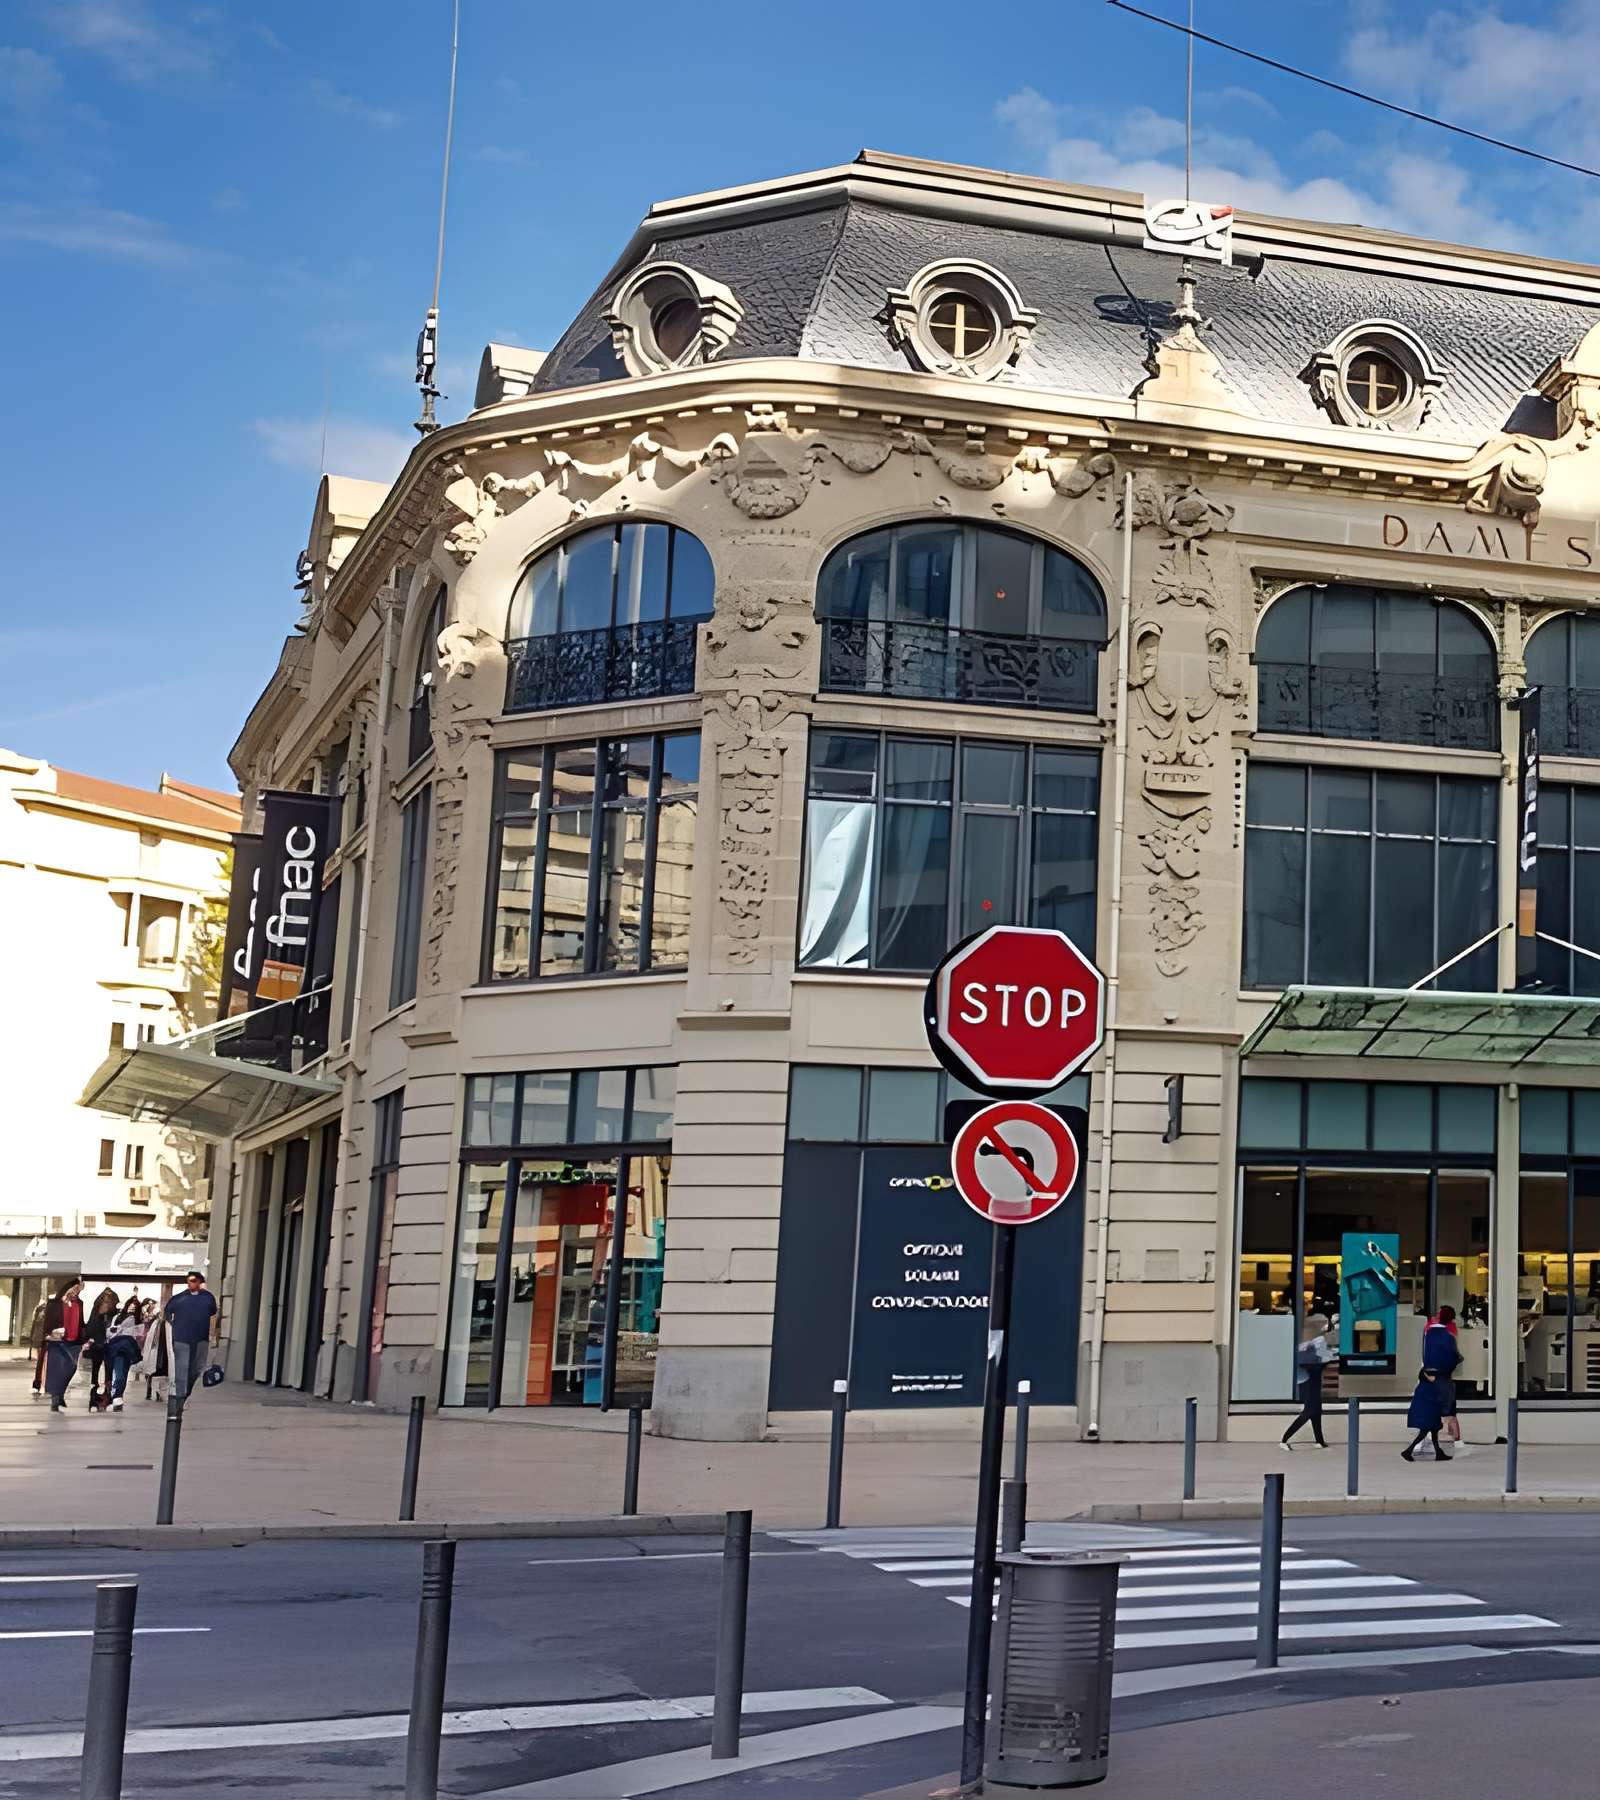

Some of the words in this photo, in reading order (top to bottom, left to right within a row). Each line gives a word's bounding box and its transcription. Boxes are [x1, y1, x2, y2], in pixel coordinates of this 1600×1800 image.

[1382, 513, 1593, 568] DAMES
[265, 825, 317, 947] fnac
[960, 982, 1087, 1029] STOP
